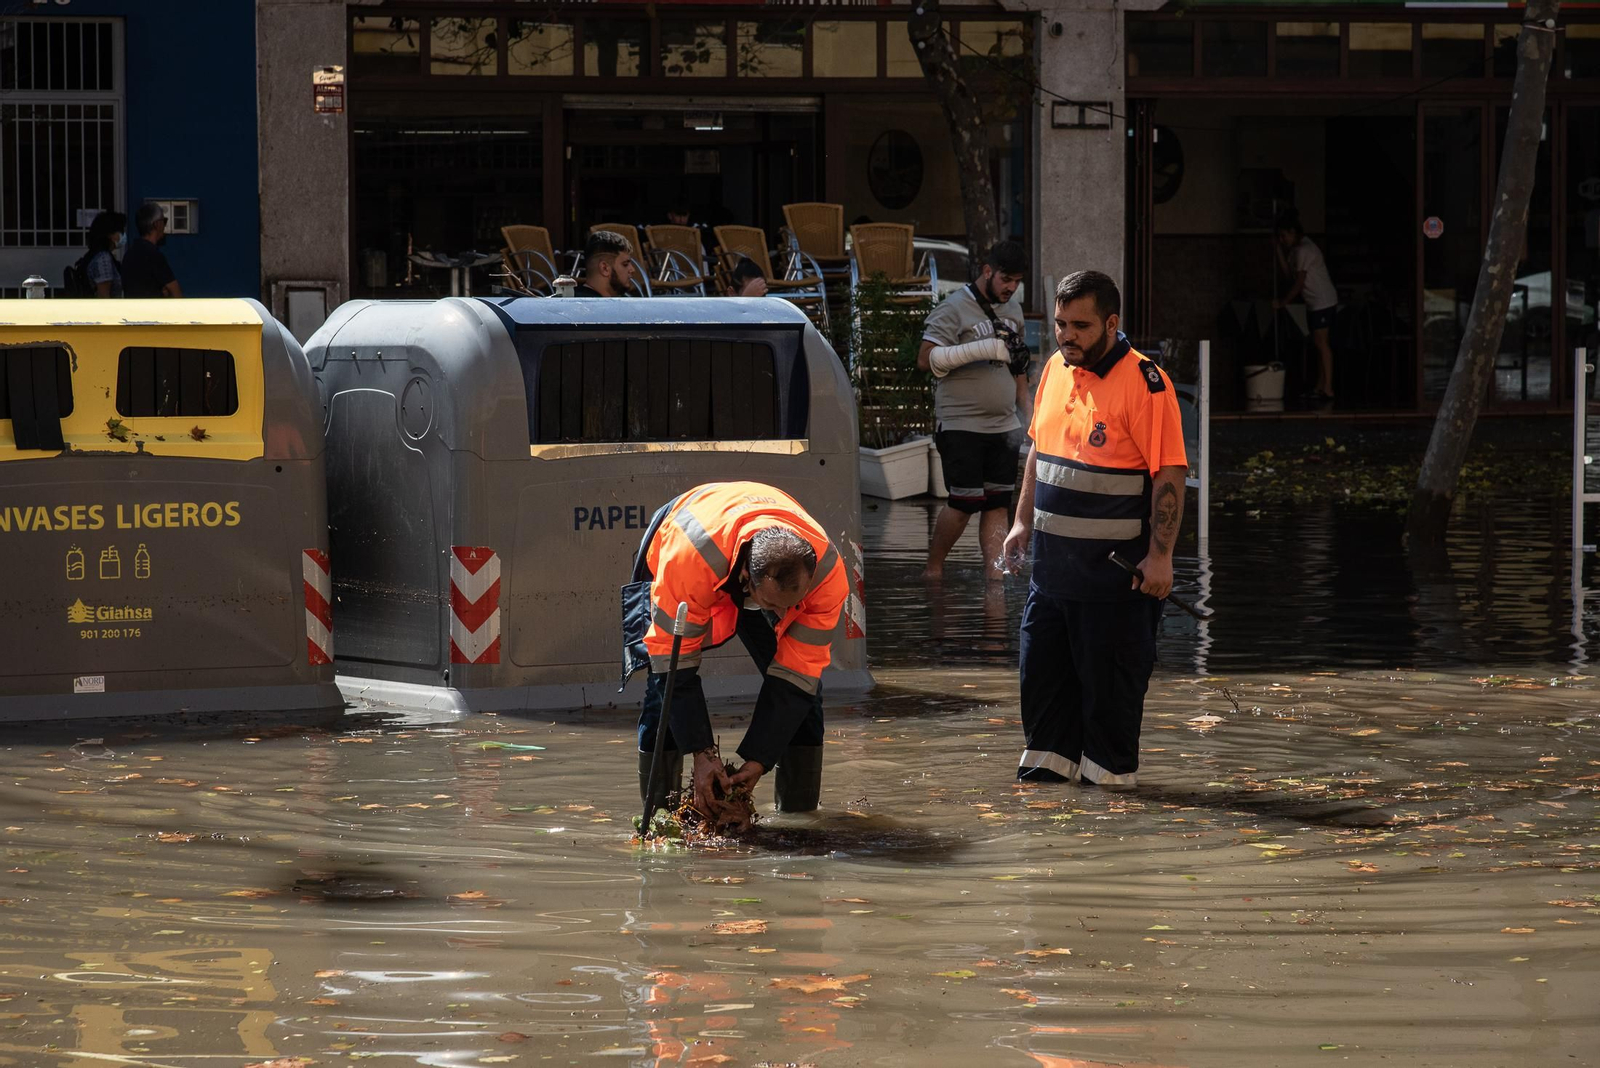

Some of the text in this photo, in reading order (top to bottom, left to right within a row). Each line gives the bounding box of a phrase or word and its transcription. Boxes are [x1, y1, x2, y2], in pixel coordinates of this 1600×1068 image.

[116, 501, 241, 529] LIGEROS
[574, 505, 649, 531] PAPEL
[80, 628, 142, 639] 901 200 176
